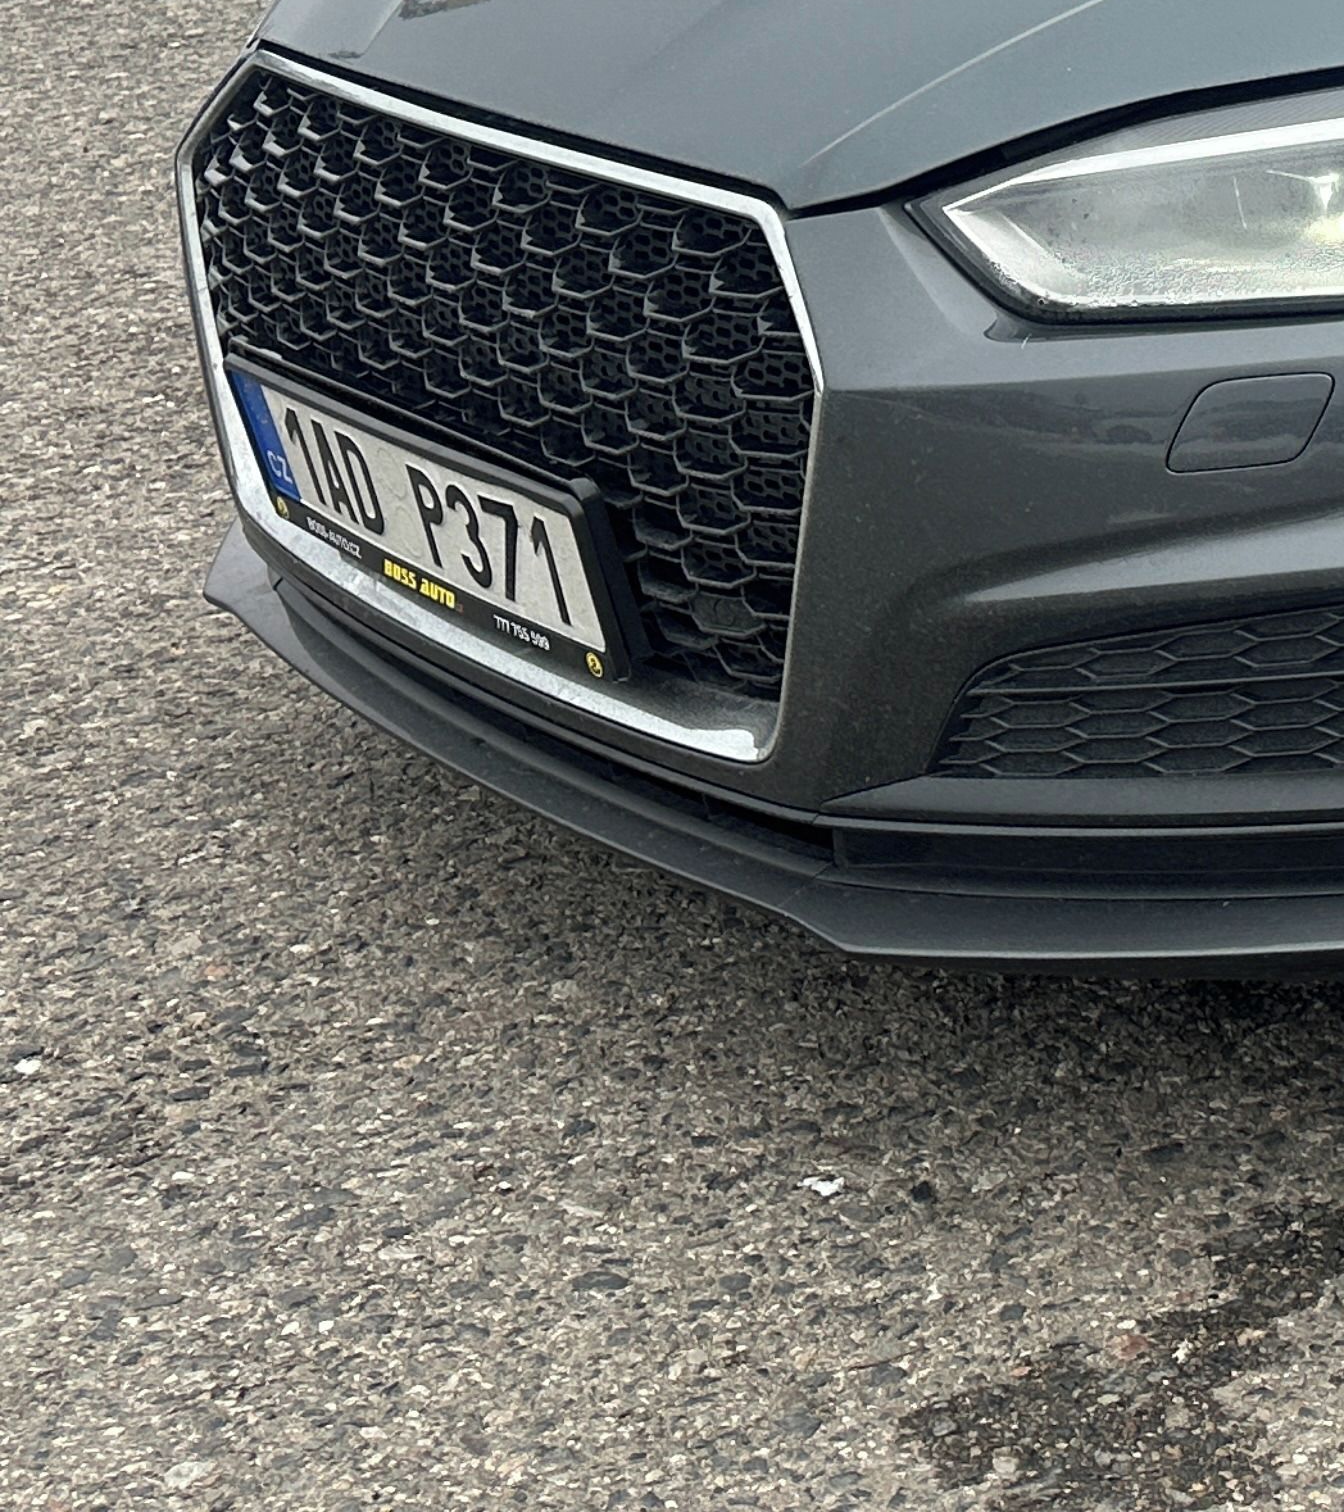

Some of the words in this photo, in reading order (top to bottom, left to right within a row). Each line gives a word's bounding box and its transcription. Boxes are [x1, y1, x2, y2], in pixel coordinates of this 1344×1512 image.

[267, 450, 294, 485] CZ
[284, 406, 385, 536] 1AD
[405, 463, 572, 627] P371
[383, 558, 417, 590] BOSS
[419, 577, 456, 609] AUTO
